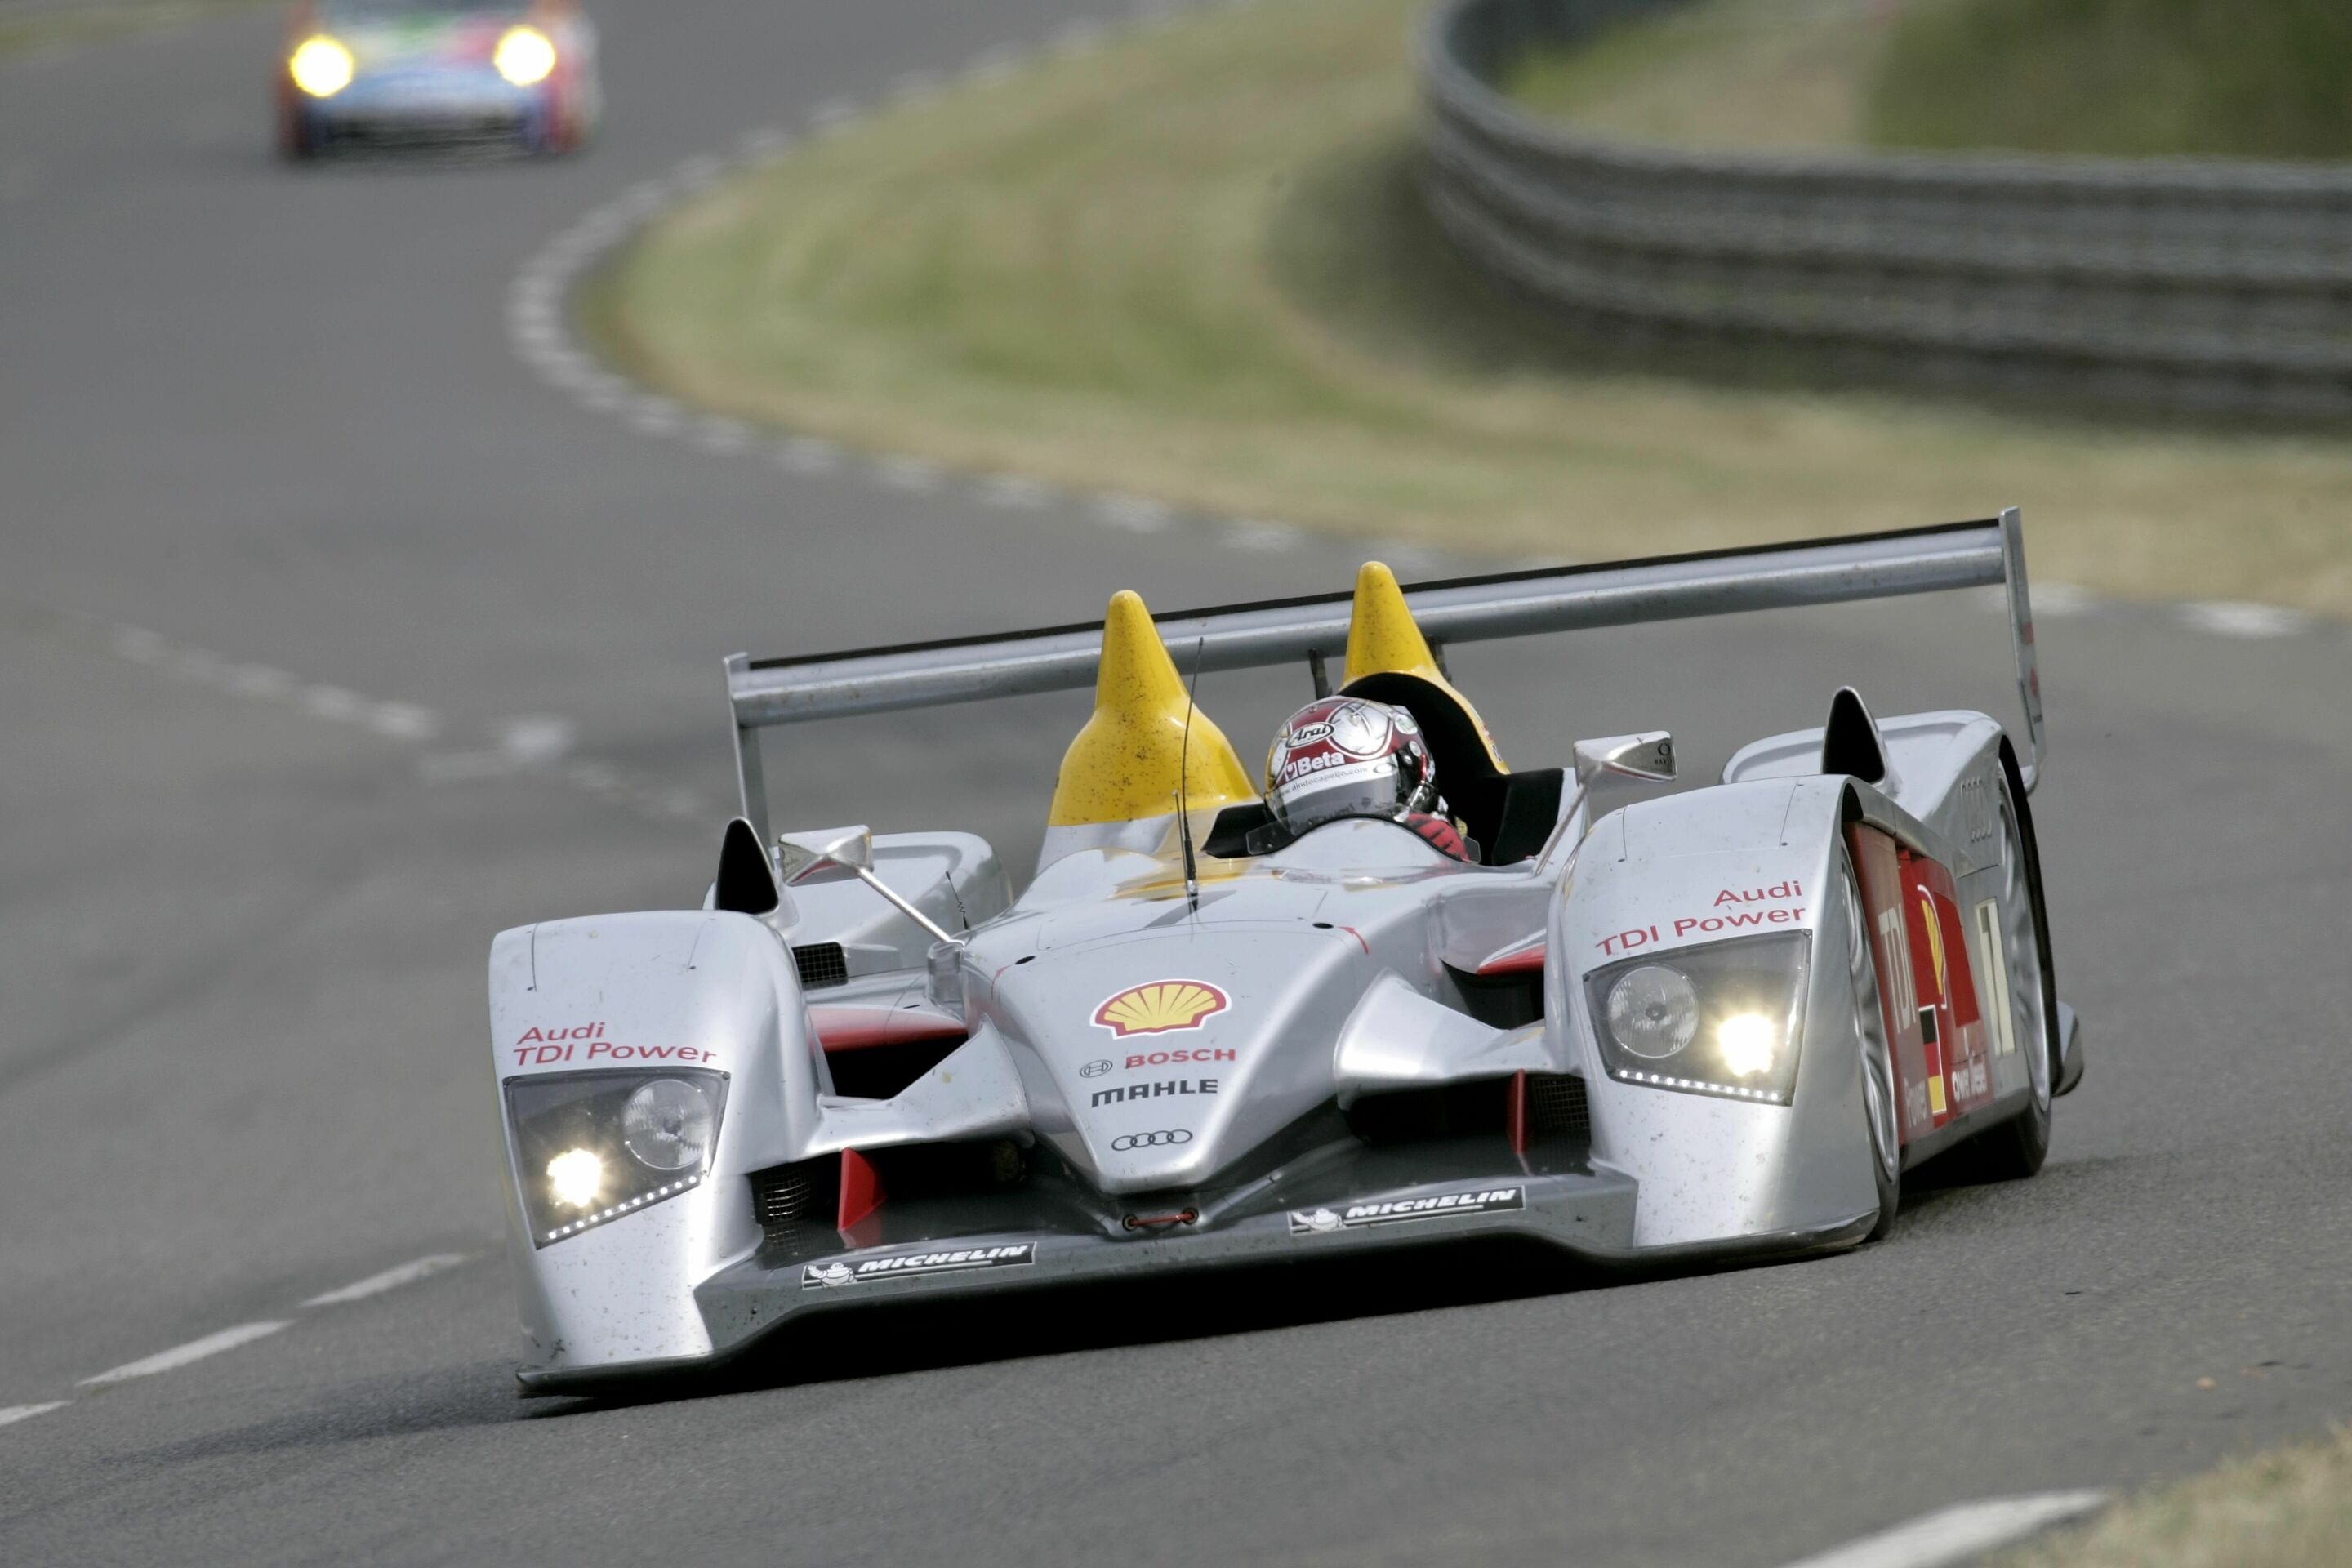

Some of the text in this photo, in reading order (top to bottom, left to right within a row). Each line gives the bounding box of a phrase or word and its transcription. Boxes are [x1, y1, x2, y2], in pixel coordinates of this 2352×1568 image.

[1293, 724, 1327, 742] Arai
[1297, 751, 1346, 776] Beta
[1713, 880, 1802, 906] Audi
[1595, 907, 1806, 956] TDI Power
[1878, 902, 1917, 1035] TDI
[516, 1022, 606, 1045] Audi
[513, 1041, 718, 1066] TDI Power
[1125, 1049, 1236, 1069] BOSCH
[1091, 1079, 1218, 1108] MAHLE
[1346, 1188, 1517, 1218] MICHELIN
[858, 1245, 1028, 1272] MICHELIN
